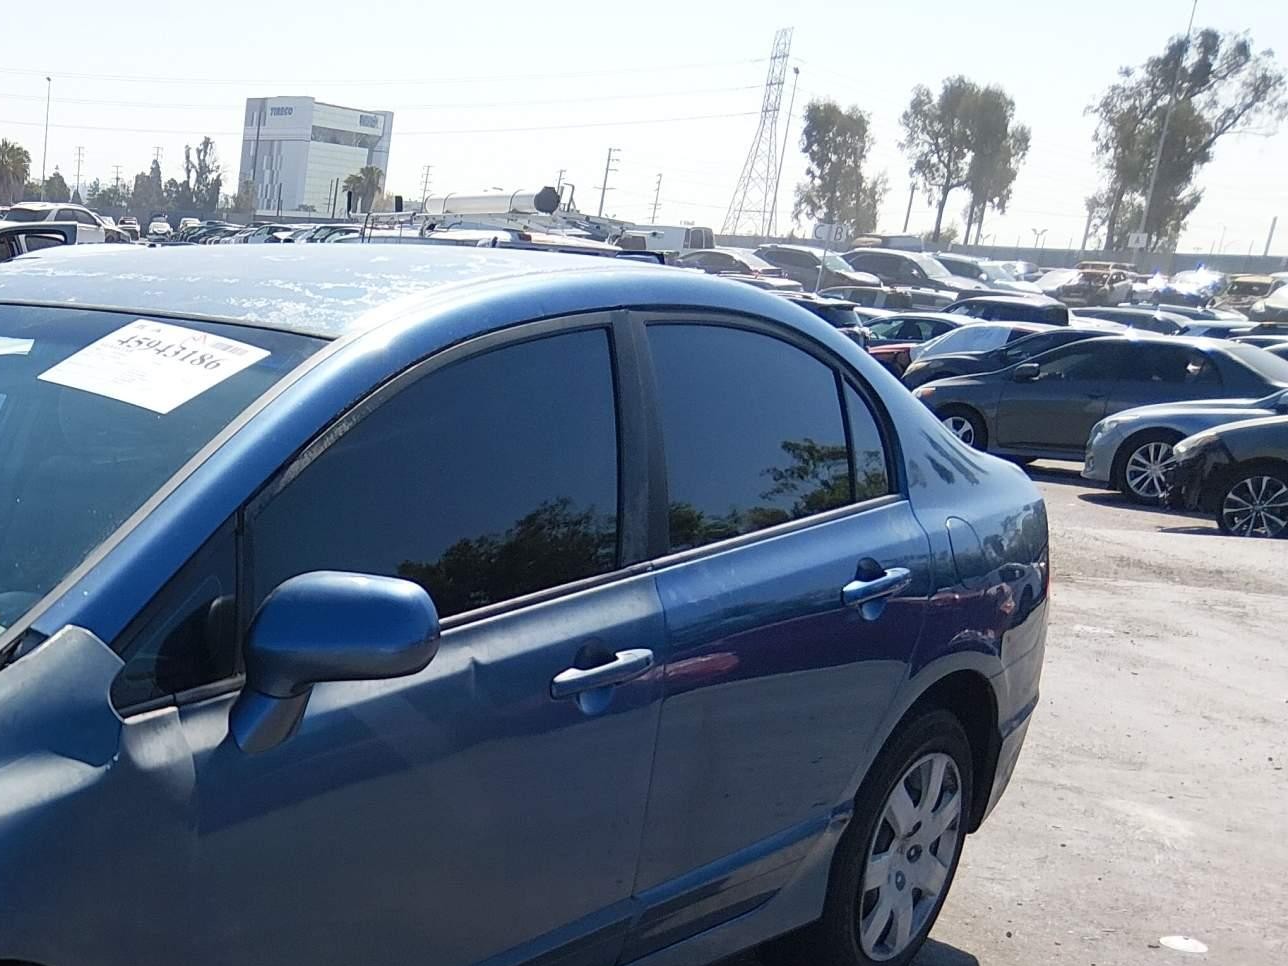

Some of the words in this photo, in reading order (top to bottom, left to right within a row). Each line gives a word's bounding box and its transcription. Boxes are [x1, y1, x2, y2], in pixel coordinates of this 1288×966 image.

[814, 224, 825, 239] C
[833, 226, 844, 241] B
[116, 335, 222, 371] 45943186
